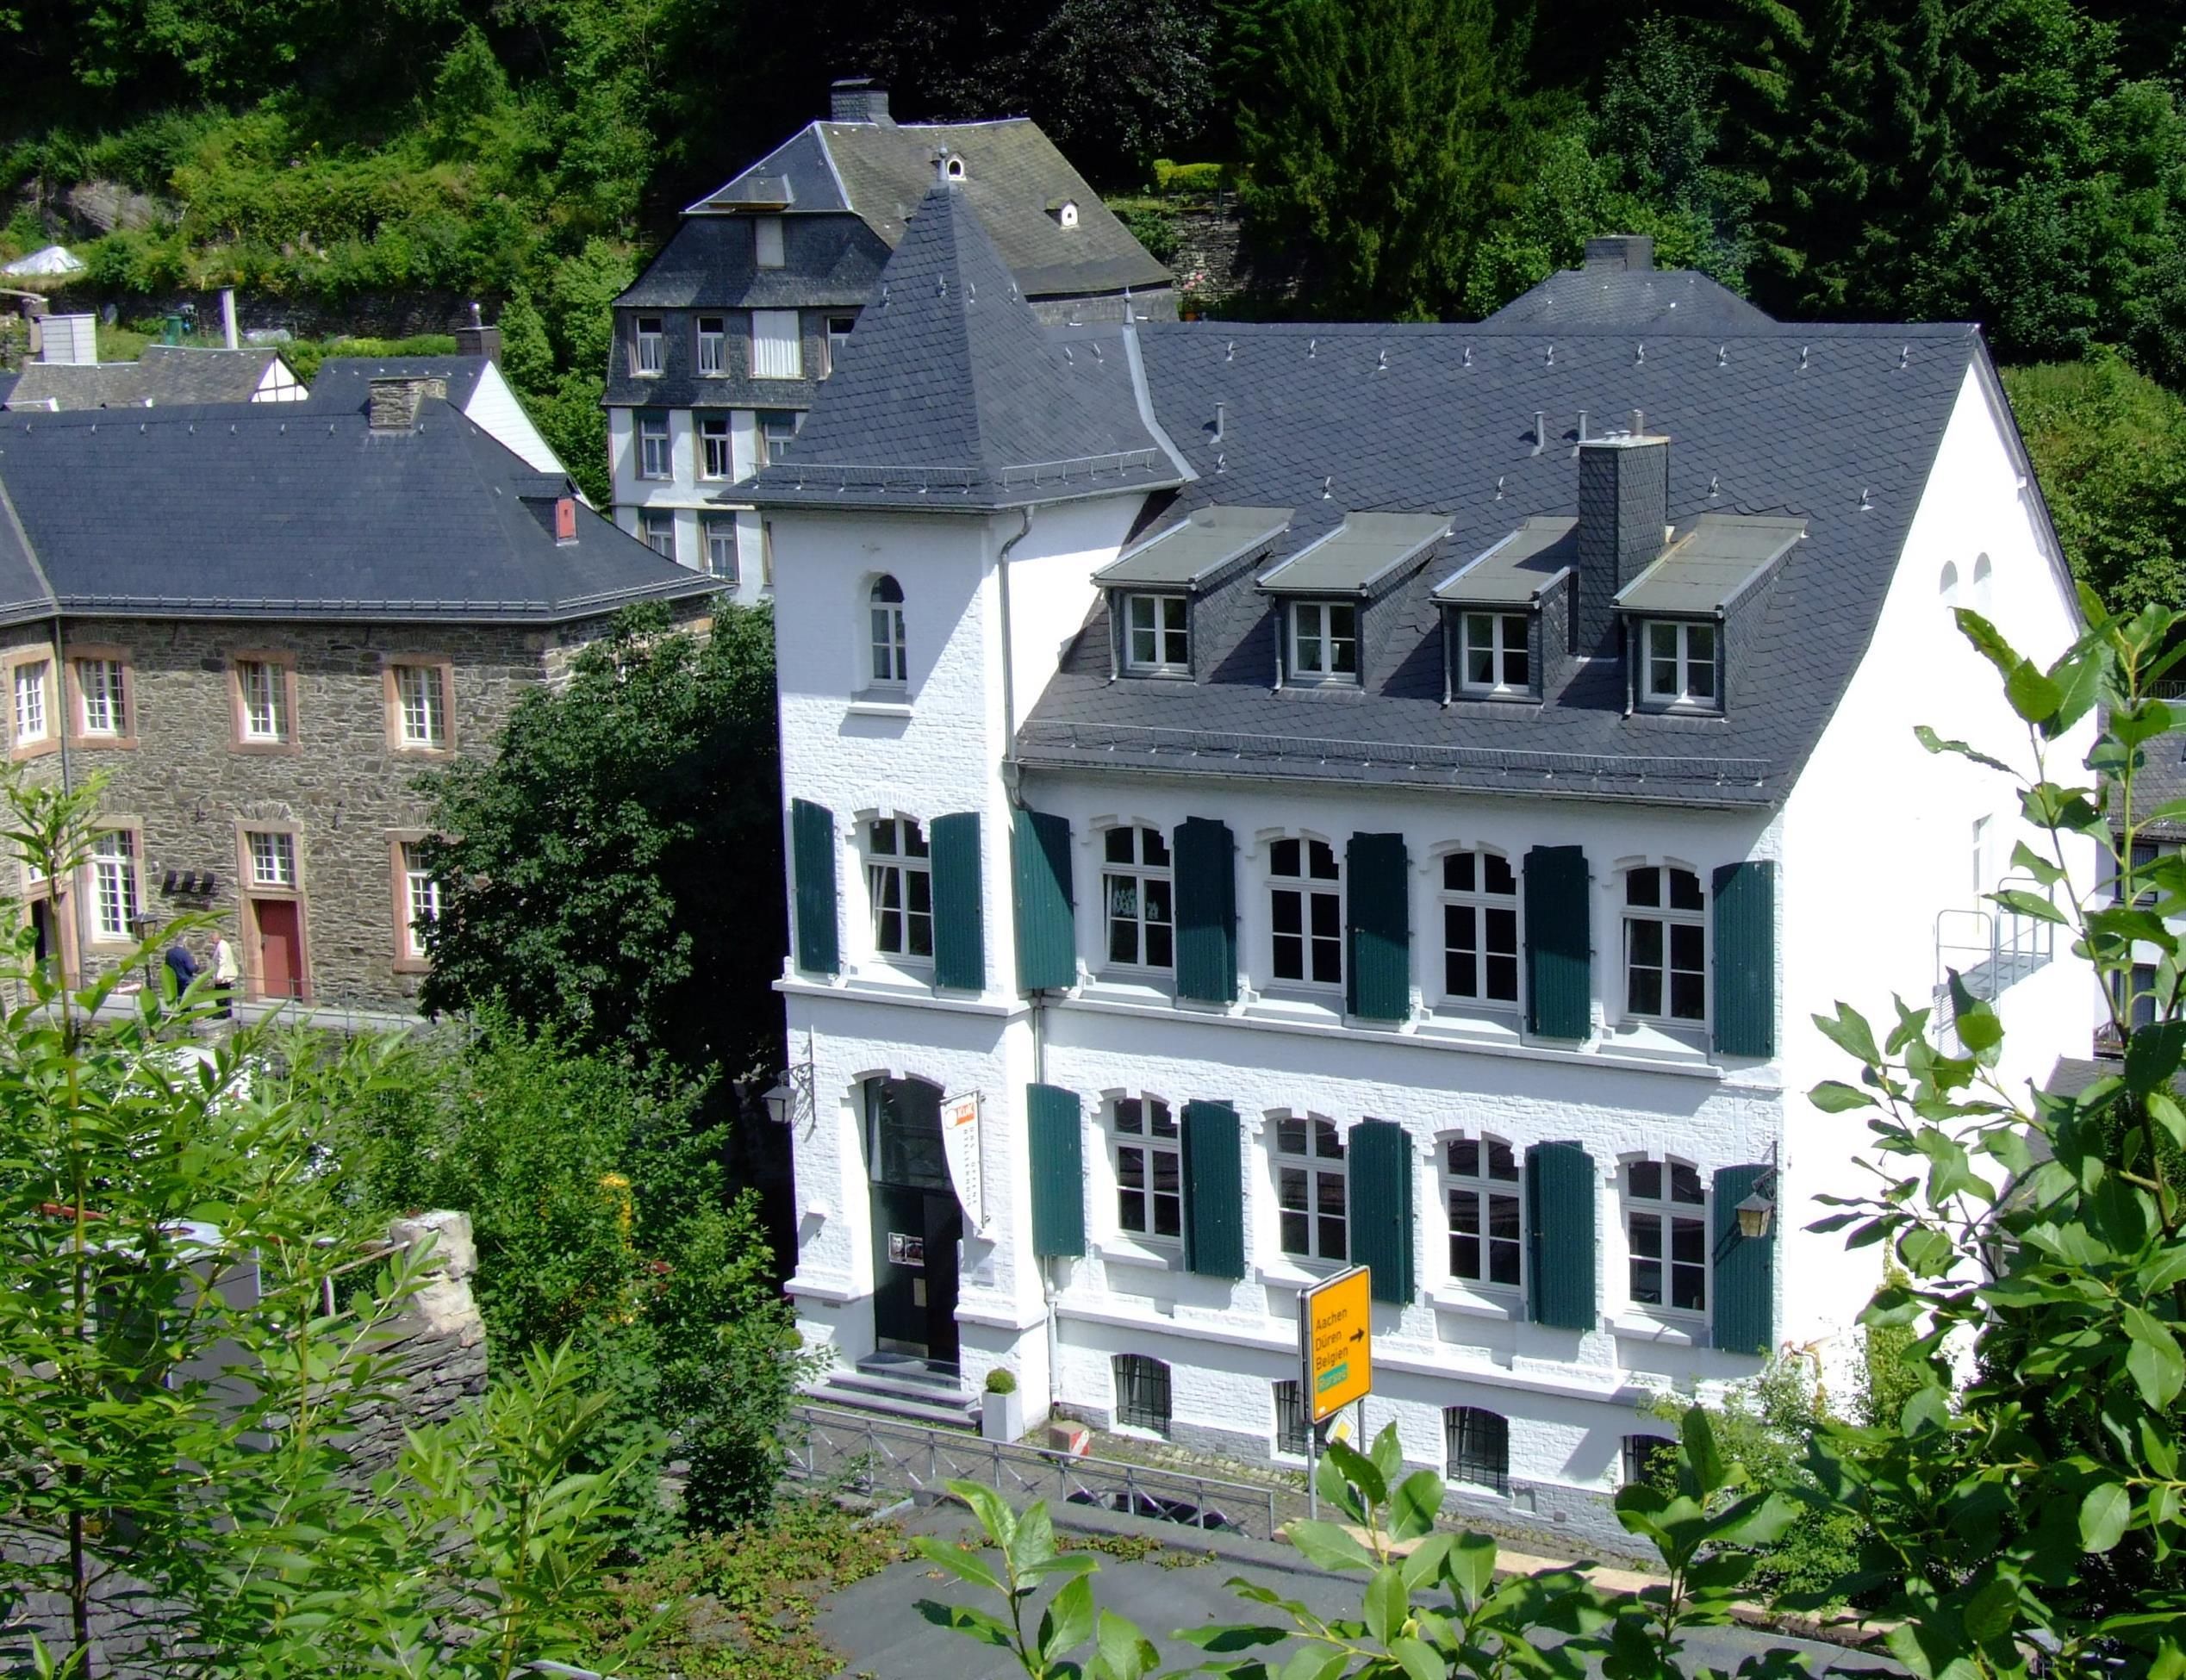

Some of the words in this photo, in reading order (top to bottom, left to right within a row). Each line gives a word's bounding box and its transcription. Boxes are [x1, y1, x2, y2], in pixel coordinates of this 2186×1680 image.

[1315, 1309, 1348, 1331] Aachen
[1316, 1330, 1342, 1352] Düren
[1316, 1346, 1348, 1371] Belgien
